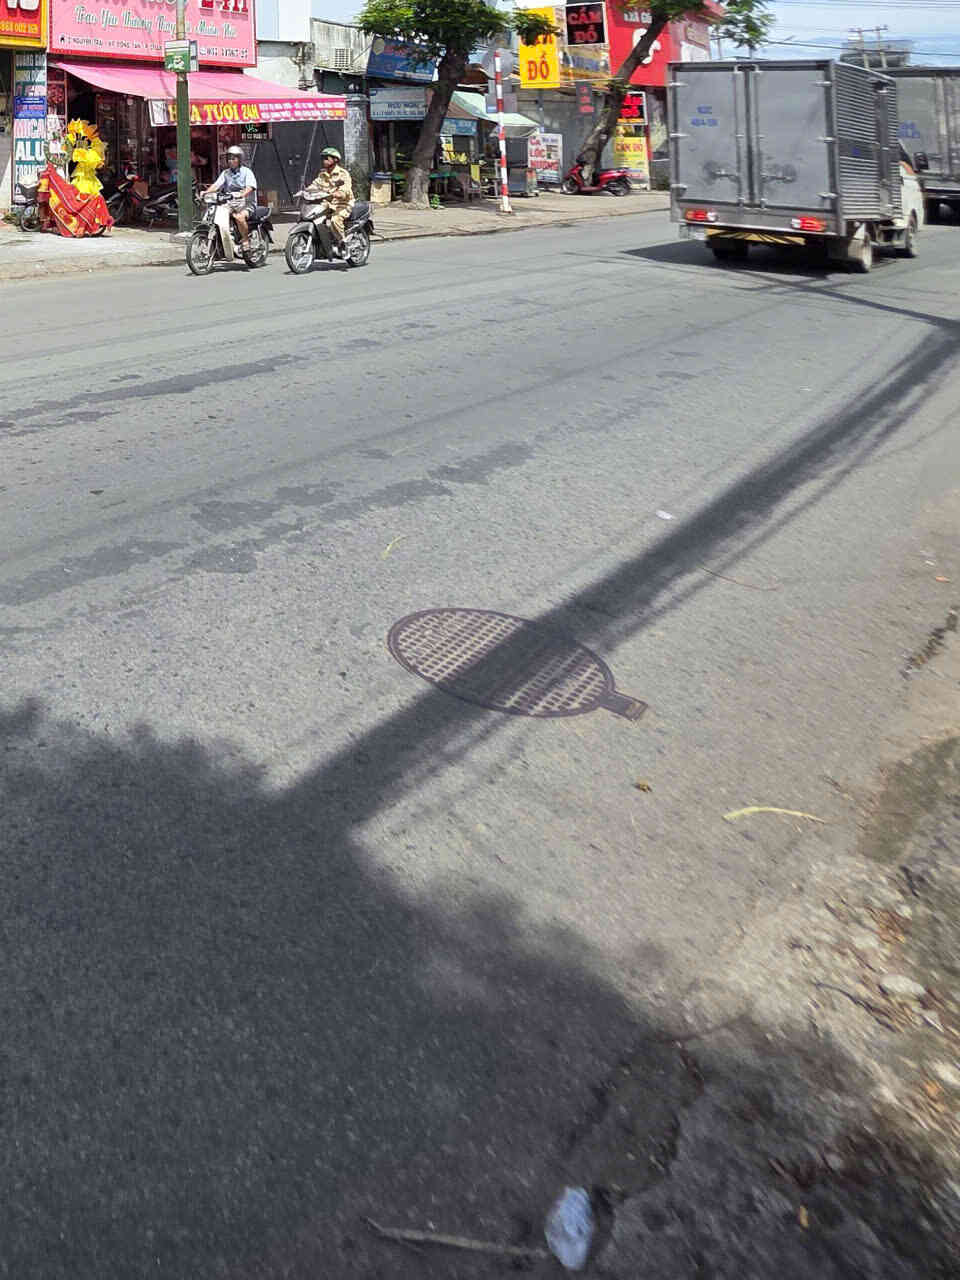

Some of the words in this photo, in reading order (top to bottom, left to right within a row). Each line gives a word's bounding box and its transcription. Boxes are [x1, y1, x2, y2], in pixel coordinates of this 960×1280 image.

[527, 51, 550, 81] ĐỒ
[168, 104, 201, 121] HA
[204, 100, 239, 120] TƯƠI
[15, 140, 46, 161] ALU
